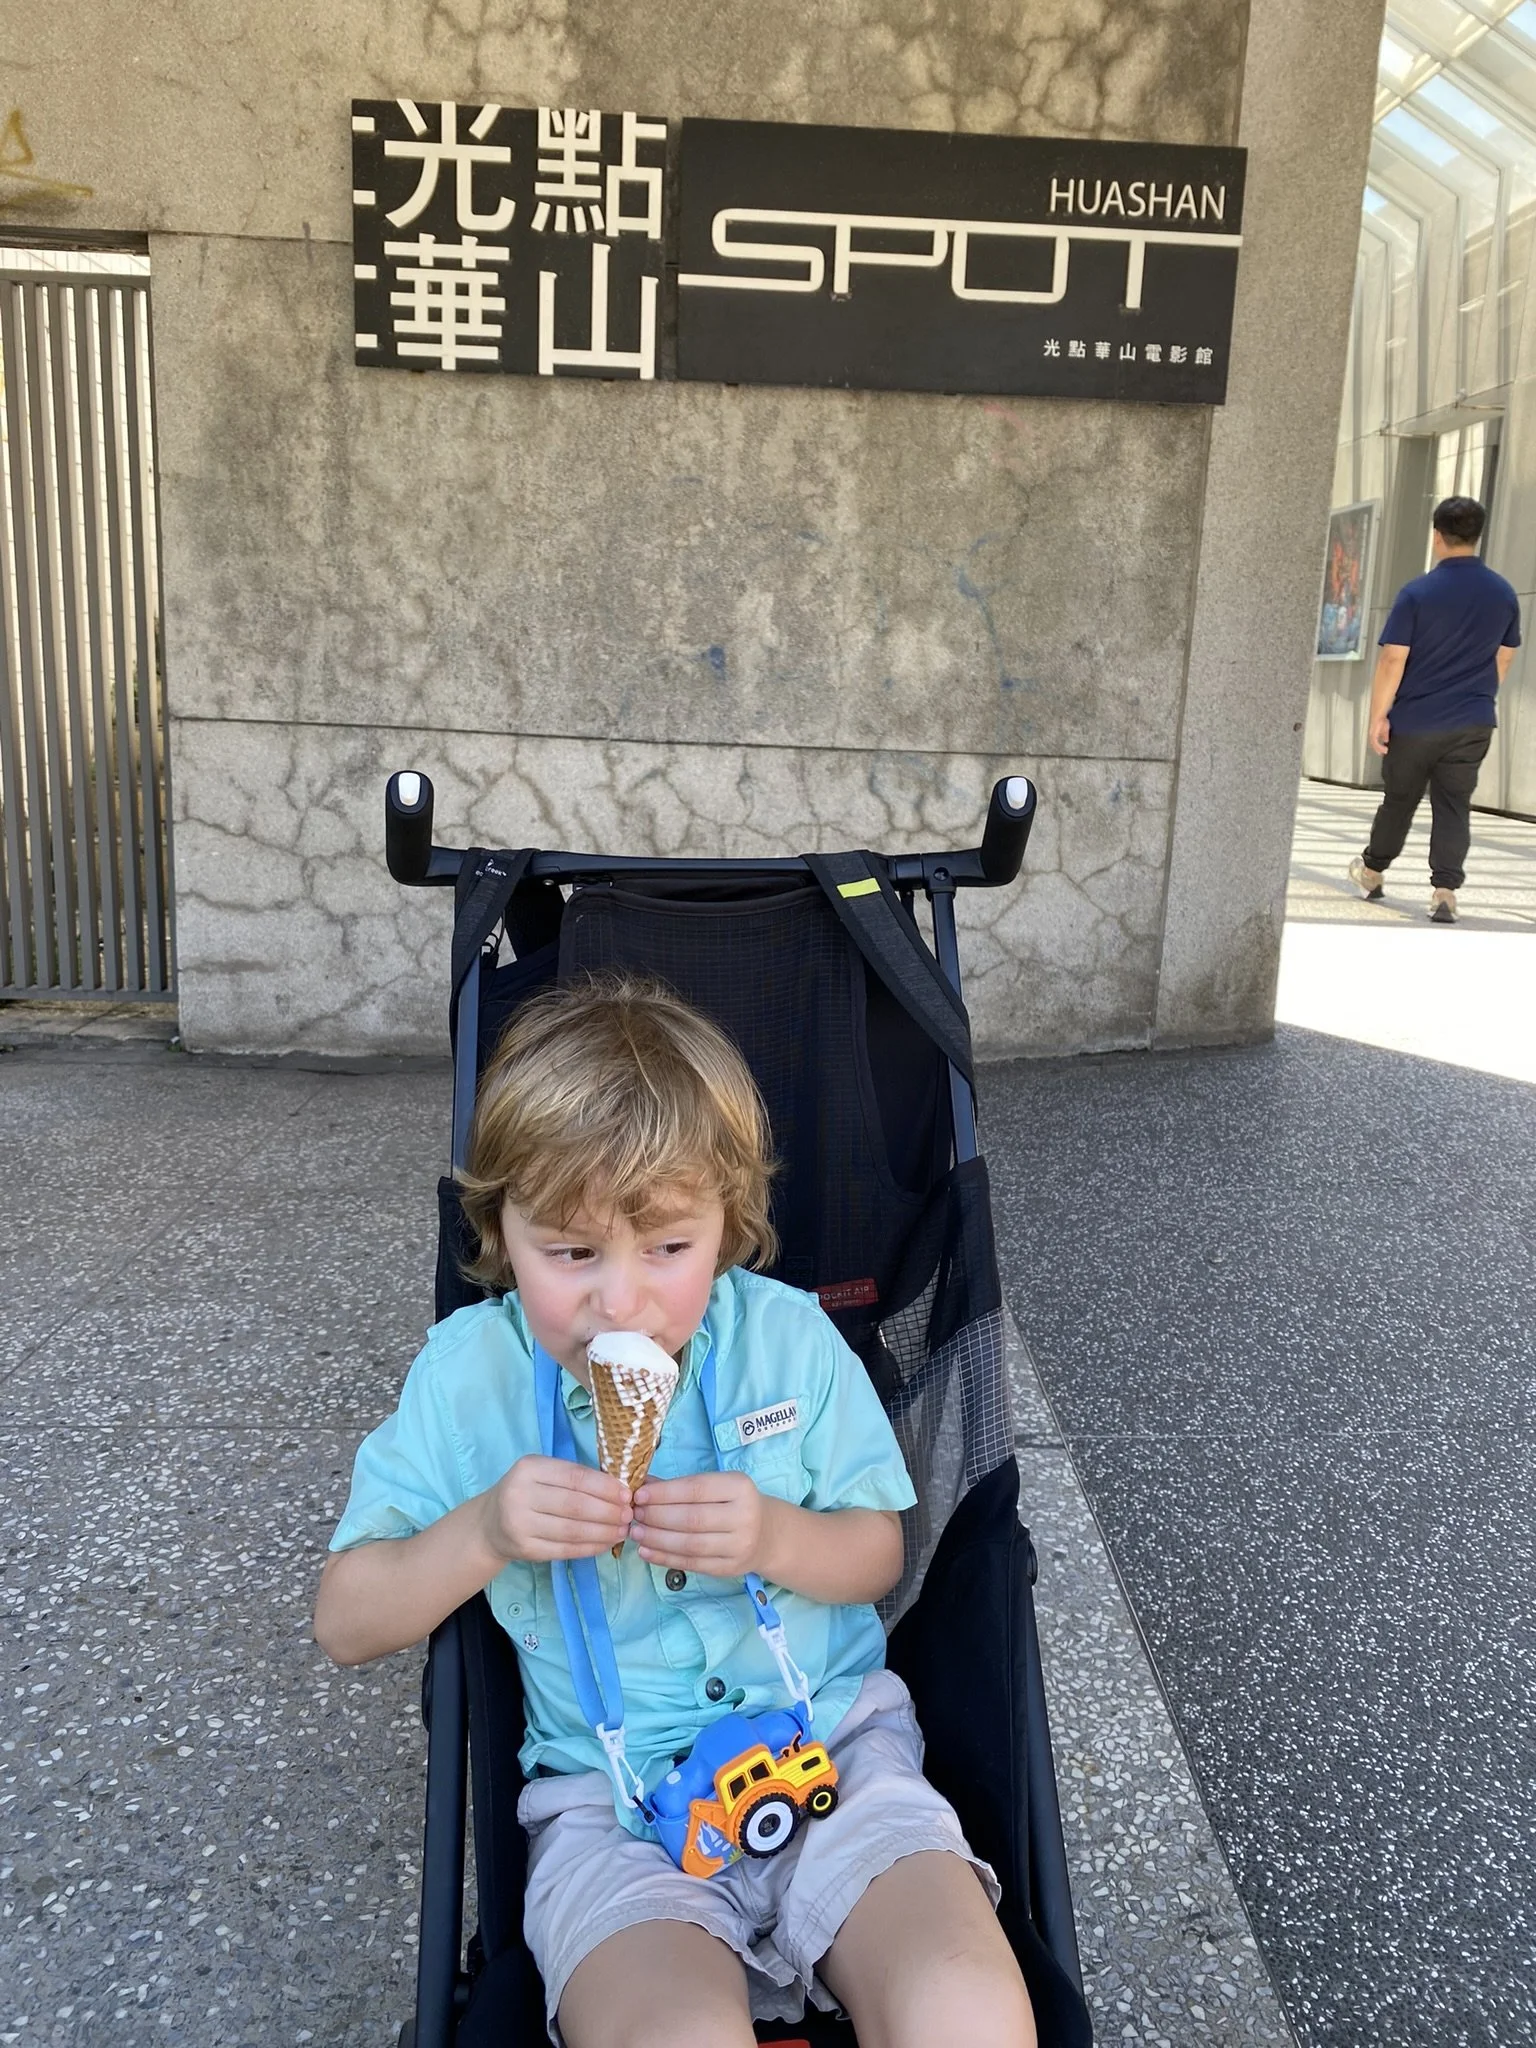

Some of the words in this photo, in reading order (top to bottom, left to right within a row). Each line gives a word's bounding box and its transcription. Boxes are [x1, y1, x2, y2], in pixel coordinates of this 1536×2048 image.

[384, 98, 667, 239] 光點
[1050, 177, 1226, 220] HUASHAN
[384, 232, 660, 379] 華山
[678, 208, 1243, 309] SPOT
[1043, 338, 1214, 365] 光點華山電影館
